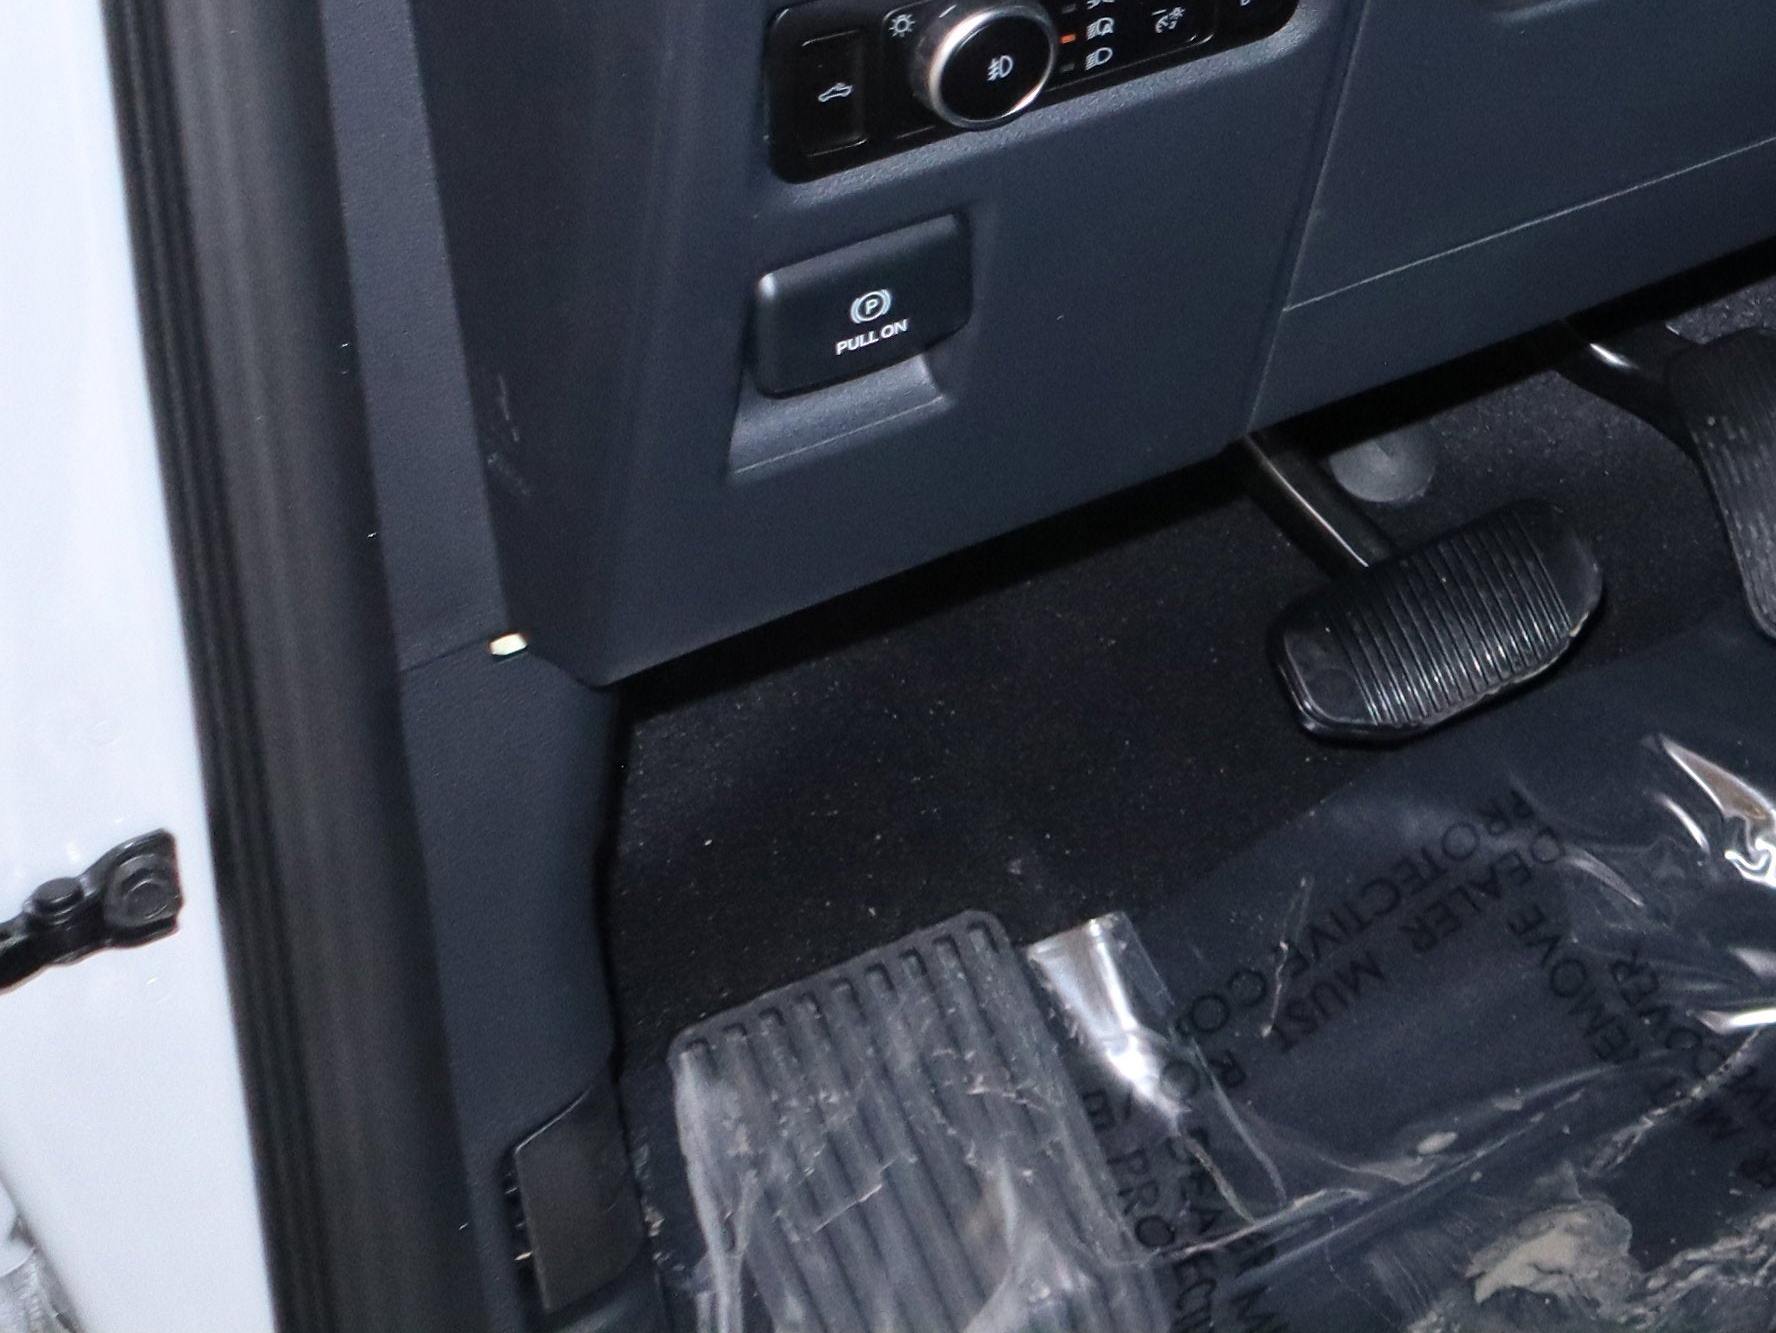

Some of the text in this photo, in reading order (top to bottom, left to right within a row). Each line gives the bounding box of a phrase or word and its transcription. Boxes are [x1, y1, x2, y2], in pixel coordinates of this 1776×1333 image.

[836, 318, 909, 356] PULL ON
[1400, 826, 1566, 953] DEALER
[1274, 952, 1386, 1054] MUST
